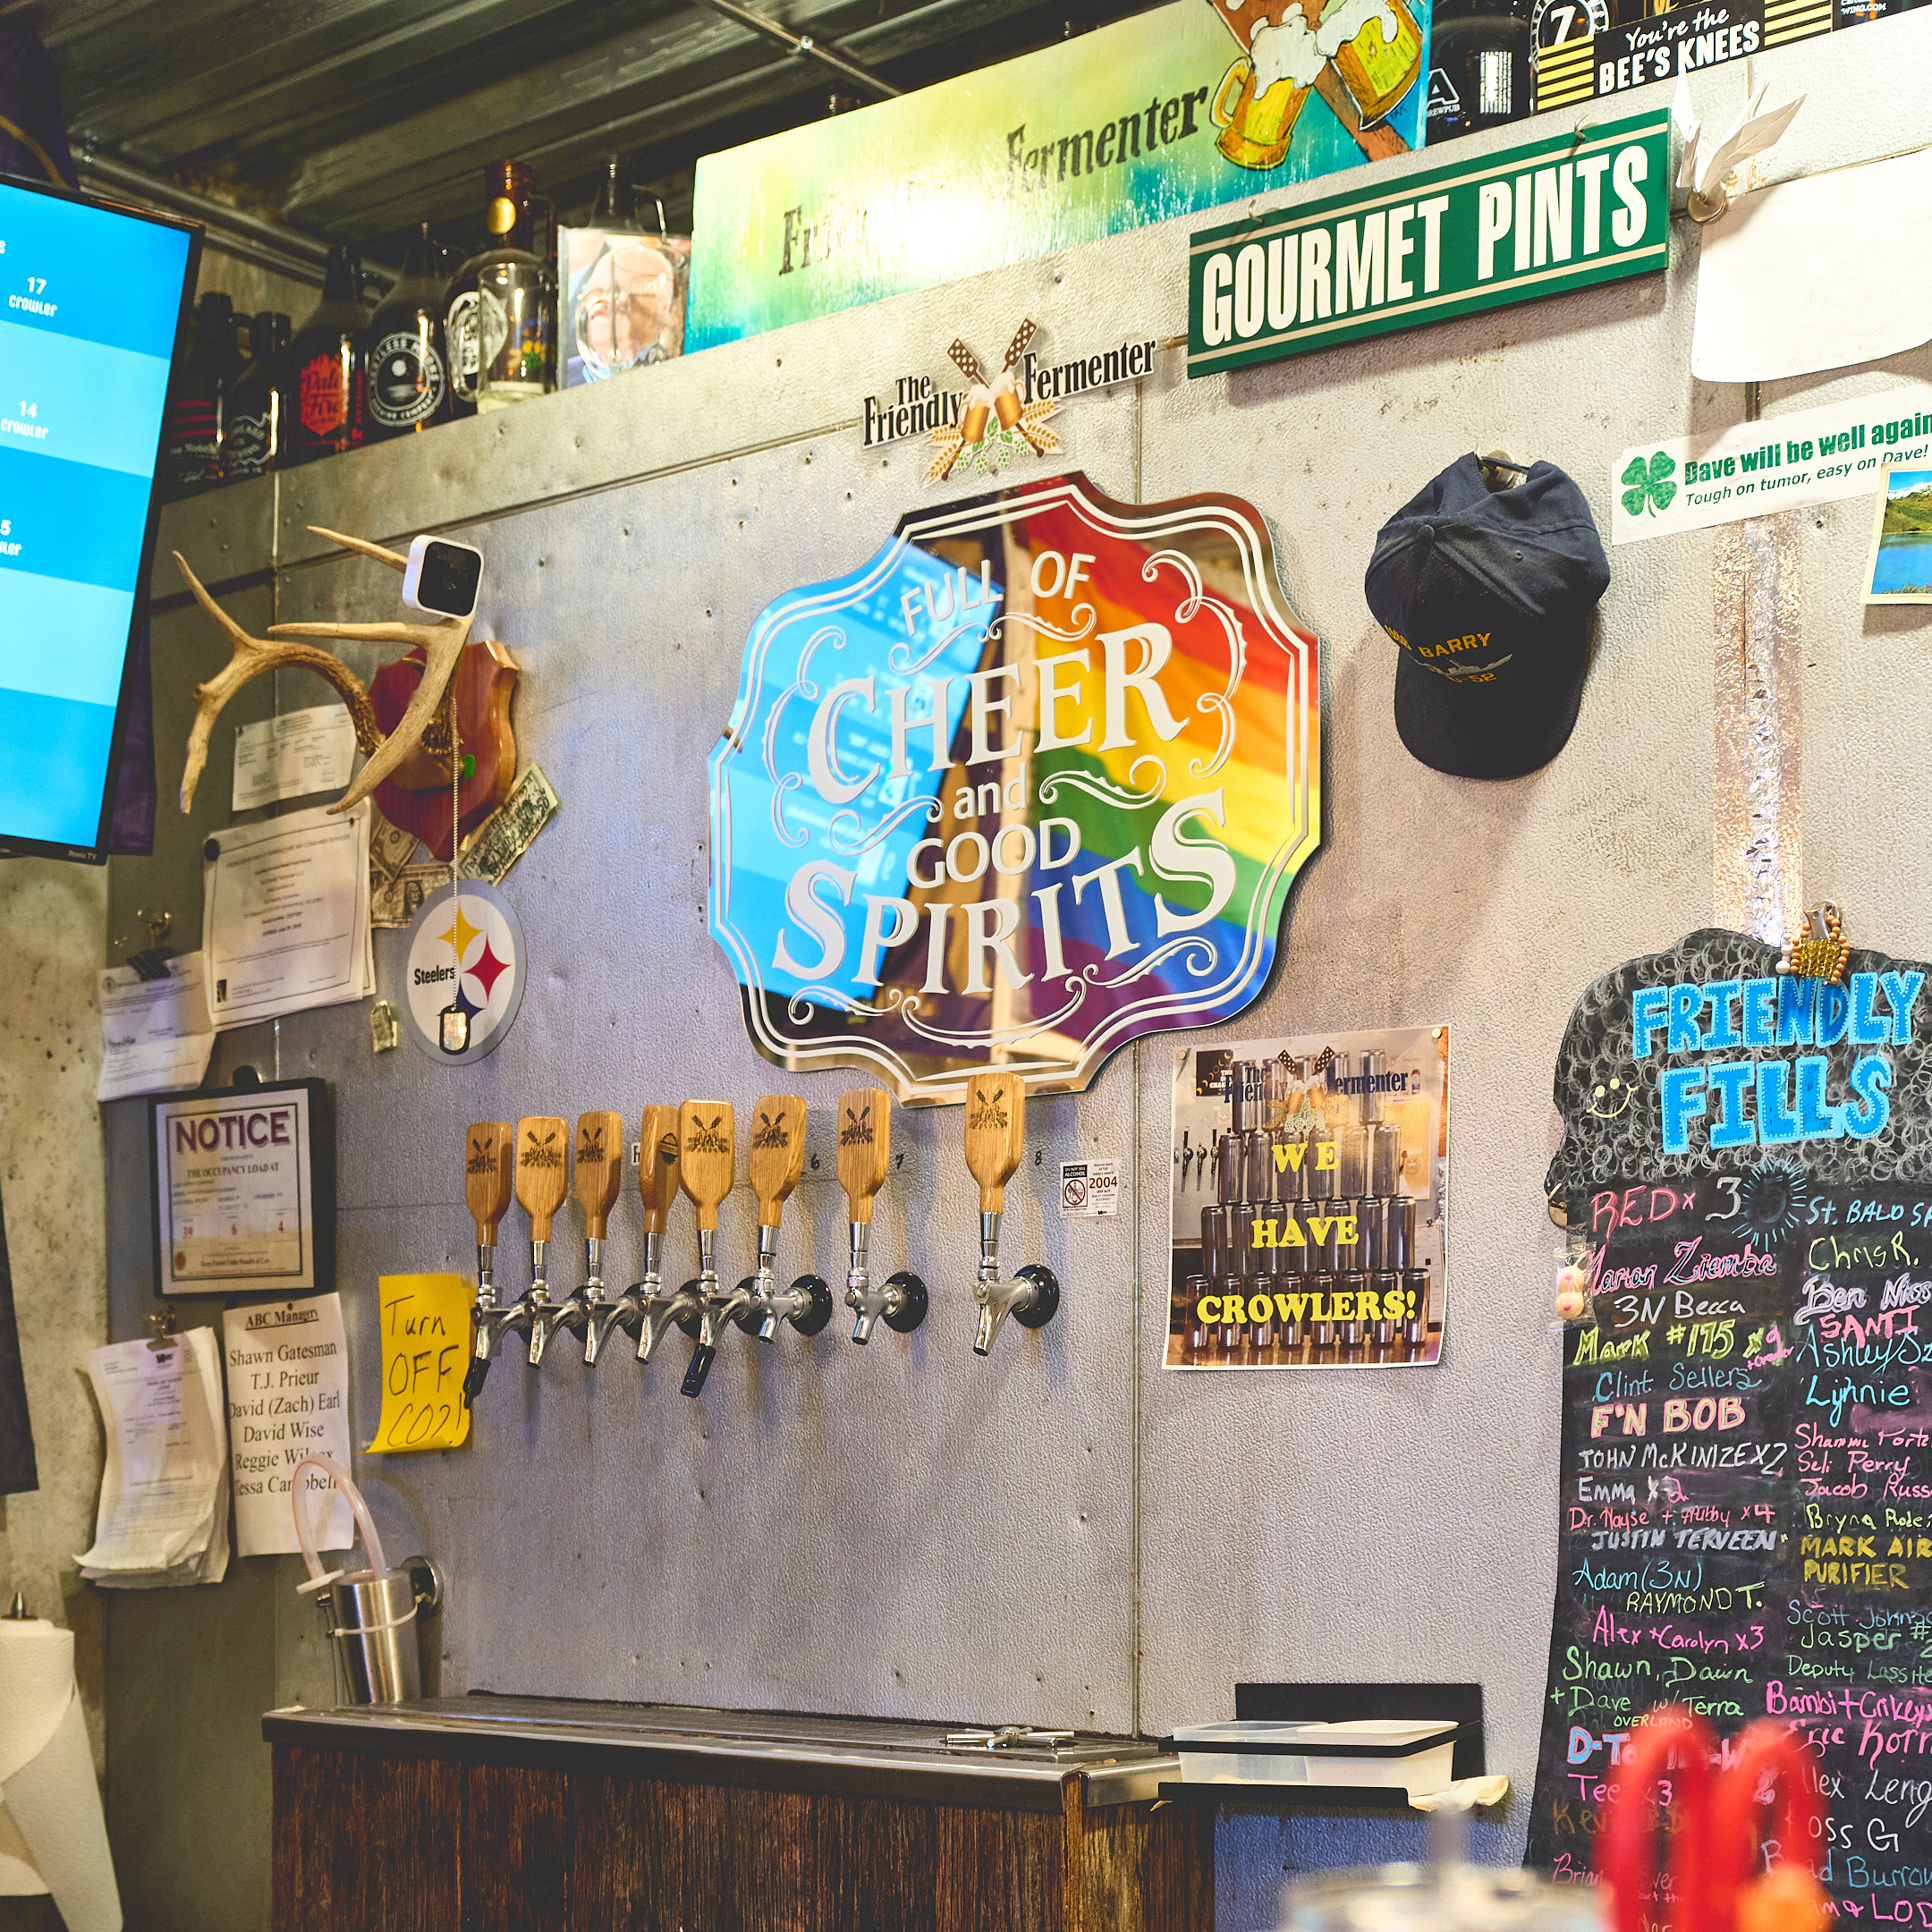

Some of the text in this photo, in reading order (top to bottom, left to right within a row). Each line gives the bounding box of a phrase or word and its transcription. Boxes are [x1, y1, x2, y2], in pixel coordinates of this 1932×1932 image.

[1626, 20, 1689, 51] You're
[1692, 7, 1729, 32] the
[1599, 20, 1760, 94] BEE'S KNEES
[1428, 104, 1461, 117] REWPUB
[1006, 87, 1209, 193] Fermenter
[1202, 145, 1648, 347] GOURMET PINTS
[27, 276, 47, 294] 17
[9, 293, 57, 317] crowler
[864, 339, 1157, 446] Friendly Fermenter
[895, 375, 931, 405] The
[18, 401, 38, 419] 14
[0, 418, 48, 440] crowler
[1685, 411, 1932, 486] Dave will be well again
[1685, 444, 1928, 510] Tough on tumor, easy on Dave!
[902, 550, 1096, 636] FULL OF
[1419, 632, 1491, 658] BARRY
[807, 622, 1190, 805] CHEER
[953, 762, 1028, 820] and
[906, 818, 1081, 889] GOOD
[772, 788, 1237, 996] SPIRITS
[413, 965, 455, 987] Steelers
[1632, 970, 1926, 1060] FRIENDLY
[1662, 1055, 1893, 1155] FILLS
[175, 1110, 291, 1154] NOTICE
[810, 1151, 820, 1169] 6
[895, 1153, 904, 1169] 7
[1034, 1149, 1043, 1165] 8
[1271, 1141, 1340, 1174] WE
[1089, 1176, 1118, 1189] 2004
[1591, 1184, 1679, 1245] RED
[1705, 1176, 1741, 1221] 3
[1805, 1195, 1904, 1225] St. BALD
[1251, 1216, 1360, 1249] HAVE
[1664, 1236, 1777, 1285] Ziemba
[1809, 1235, 1886, 1270] Chris
[385, 1294, 446, 1336] Turn
[1197, 1291, 1417, 1325] CROWLERS!
[1614, 1290, 1745, 1328] 3N Becca
[1793, 1274, 1867, 1326] Ben
[246, 1314, 270, 1328] ABC
[1819, 1304, 1920, 1348] SANTI
[1666, 1318, 1735, 1360] #175
[230, 1343, 337, 1368] Shawn Gatesman
[389, 1344, 459, 1395] OFF
[250, 1369, 319, 1390] T.J. Prieur
[1593, 1362, 1763, 1402] Clint Sellers
[230, 1390, 340, 1419] David (Zach) Earl
[1590, 1396, 1746, 1439] F'N BOB
[243, 1422, 325, 1444] David Wise
[236, 1448, 334, 1473] Reggie Wilx
[1579, 1445, 1637, 1470] JOHN
[1847, 1450, 1911, 1481] Perry
[268, 1474, 337, 1493] Cabell
[1578, 1476, 1636, 1504] Emma
[1801, 1472, 1932, 1501] Jacob Russ
[1569, 1506, 1597, 1531] Dr.
[1591, 1527, 1777, 1551] JUSTIN TERVEEN
[1801, 1535, 1932, 1558] MARK AIR
[1804, 1559, 1909, 1589] PURIFIER
[1626, 1587, 1733, 1614] RAYMOND
[1593, 1605, 1642, 1647] Alex
[1801, 1623, 1902, 1654] Jasper
[1785, 1655, 1856, 1683] Deputy
[1682, 1695, 1745, 1717] Terra
[1614, 1714, 1693, 1731] OVERLAND
[1801, 1766, 1845, 1799] lex
[1800, 1811, 1900, 1852] oss G
